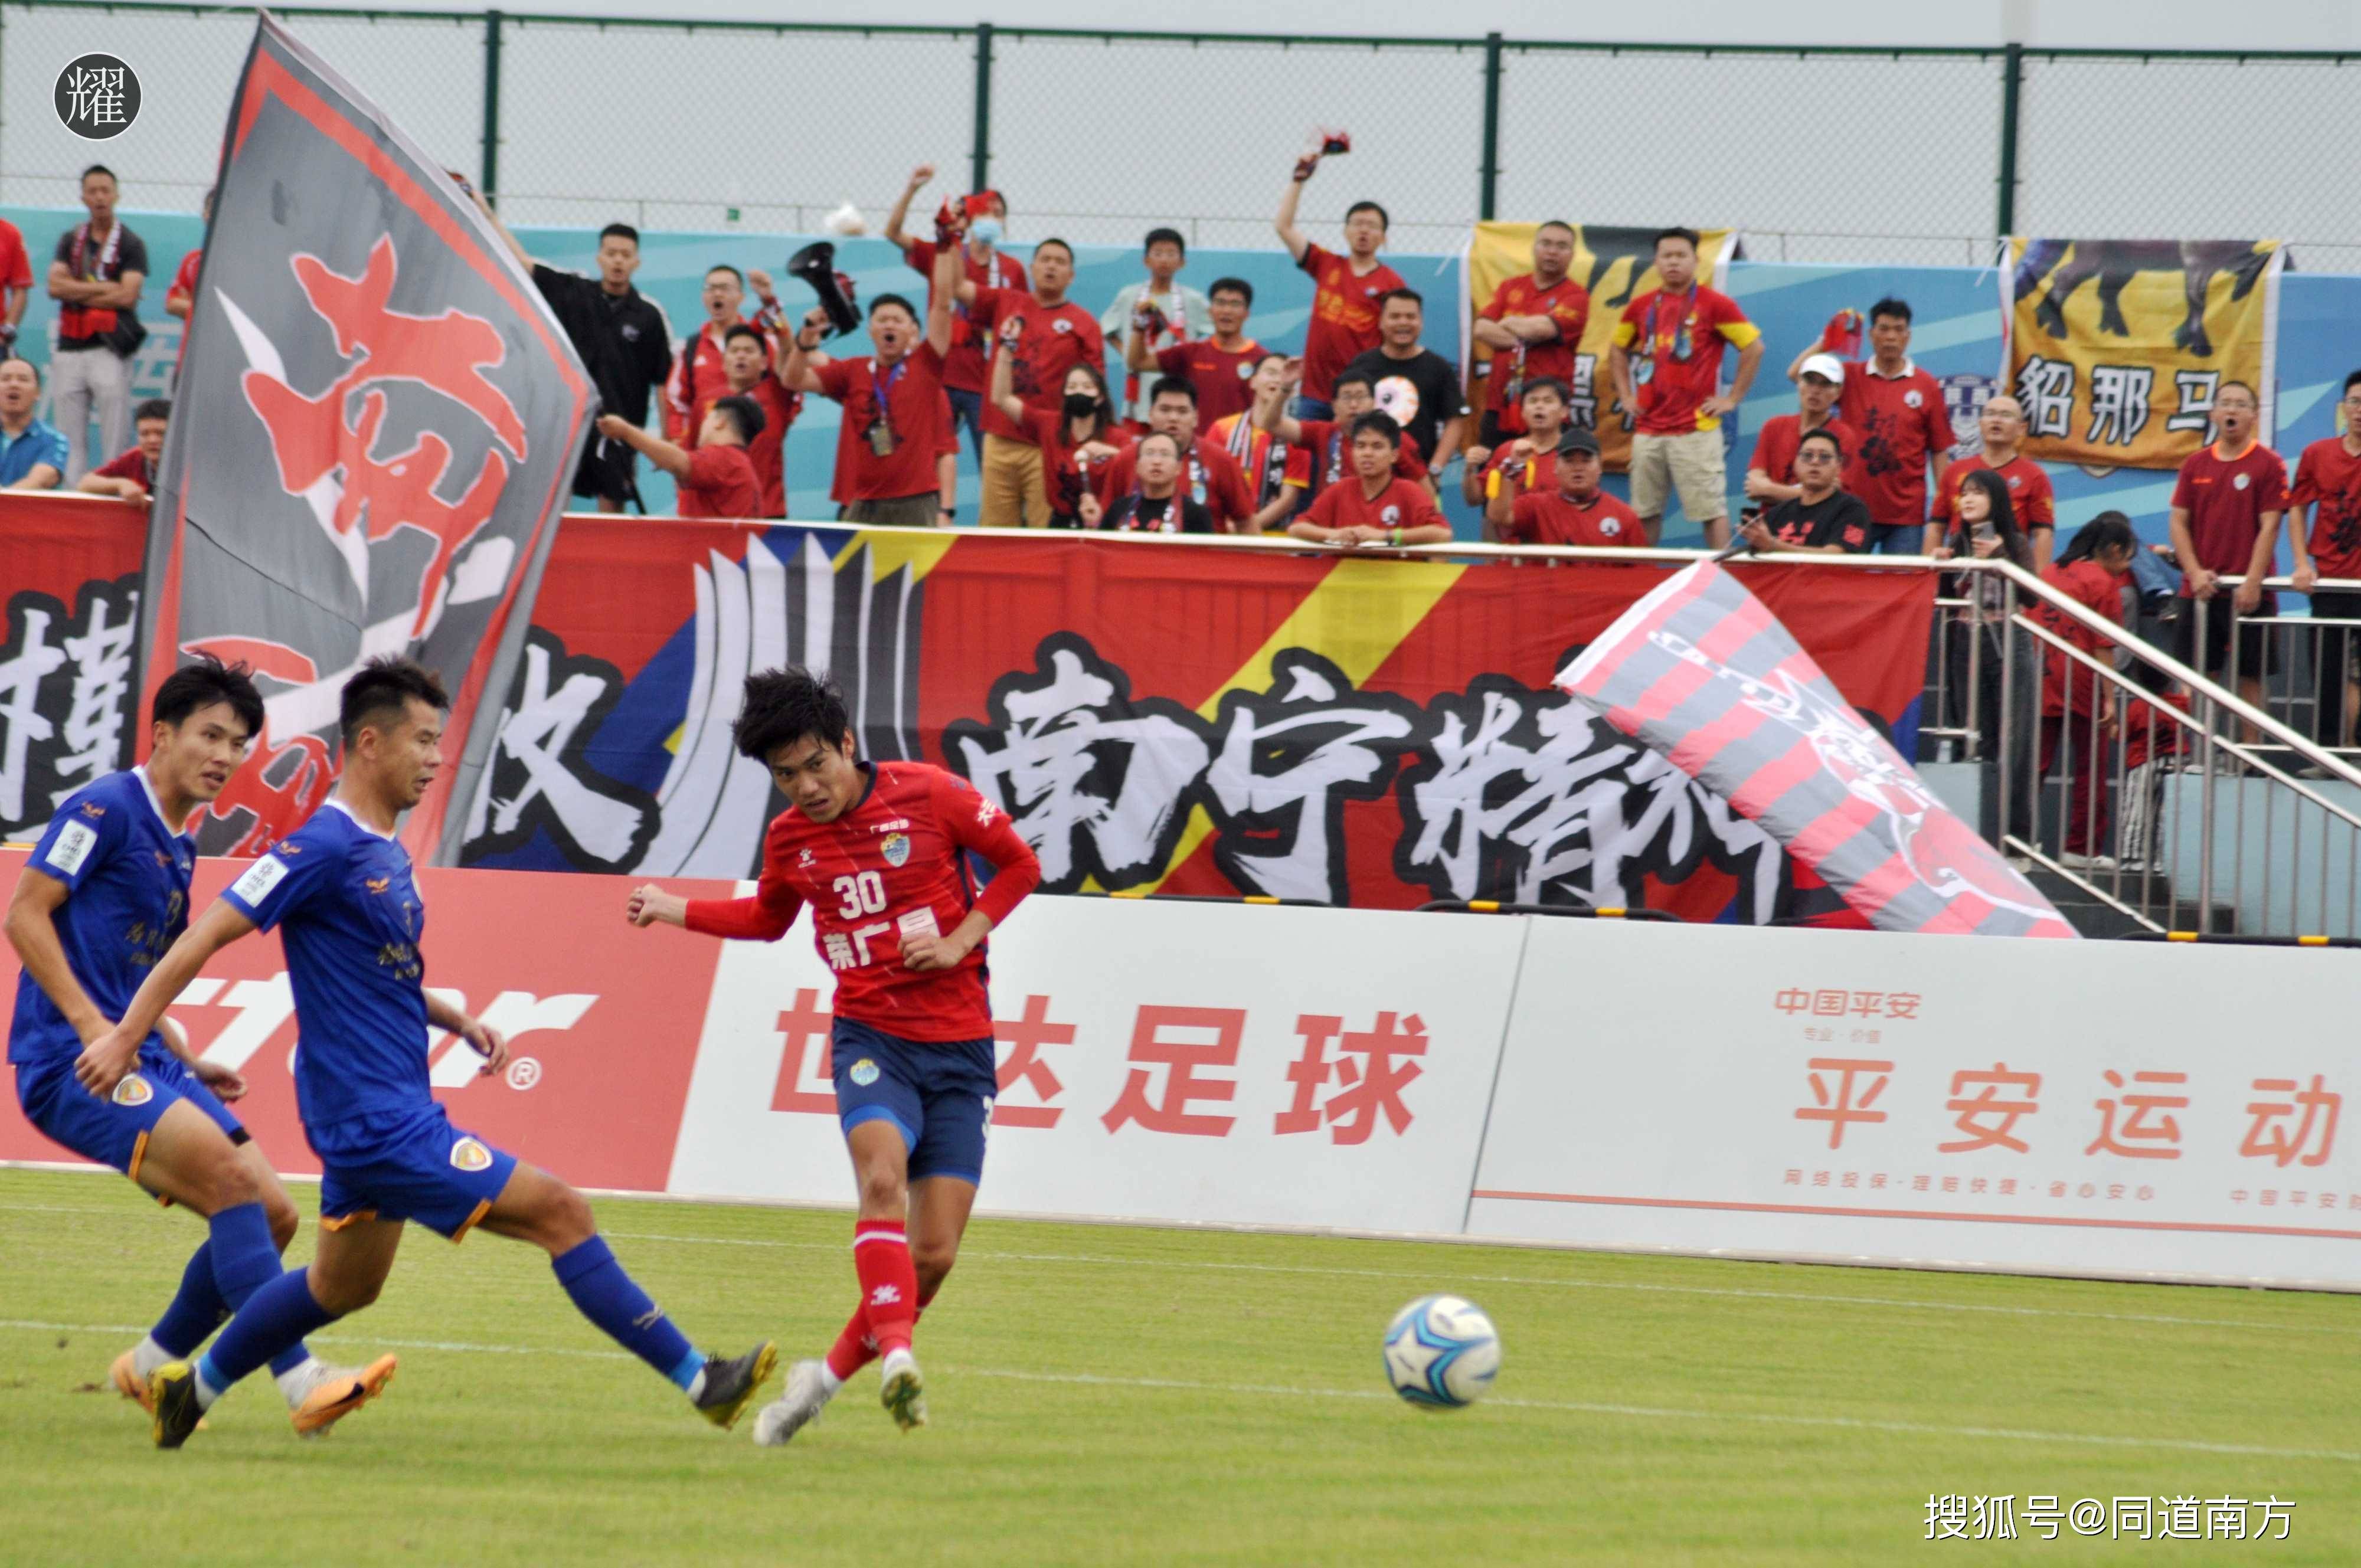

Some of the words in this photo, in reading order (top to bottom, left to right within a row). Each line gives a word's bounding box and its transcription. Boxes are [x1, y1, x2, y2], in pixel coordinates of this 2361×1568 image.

[833, 870, 886, 919] 30
[1774, 987, 1921, 1020] 中国平安
[1794, 1057, 2343, 1168] 平安运动
